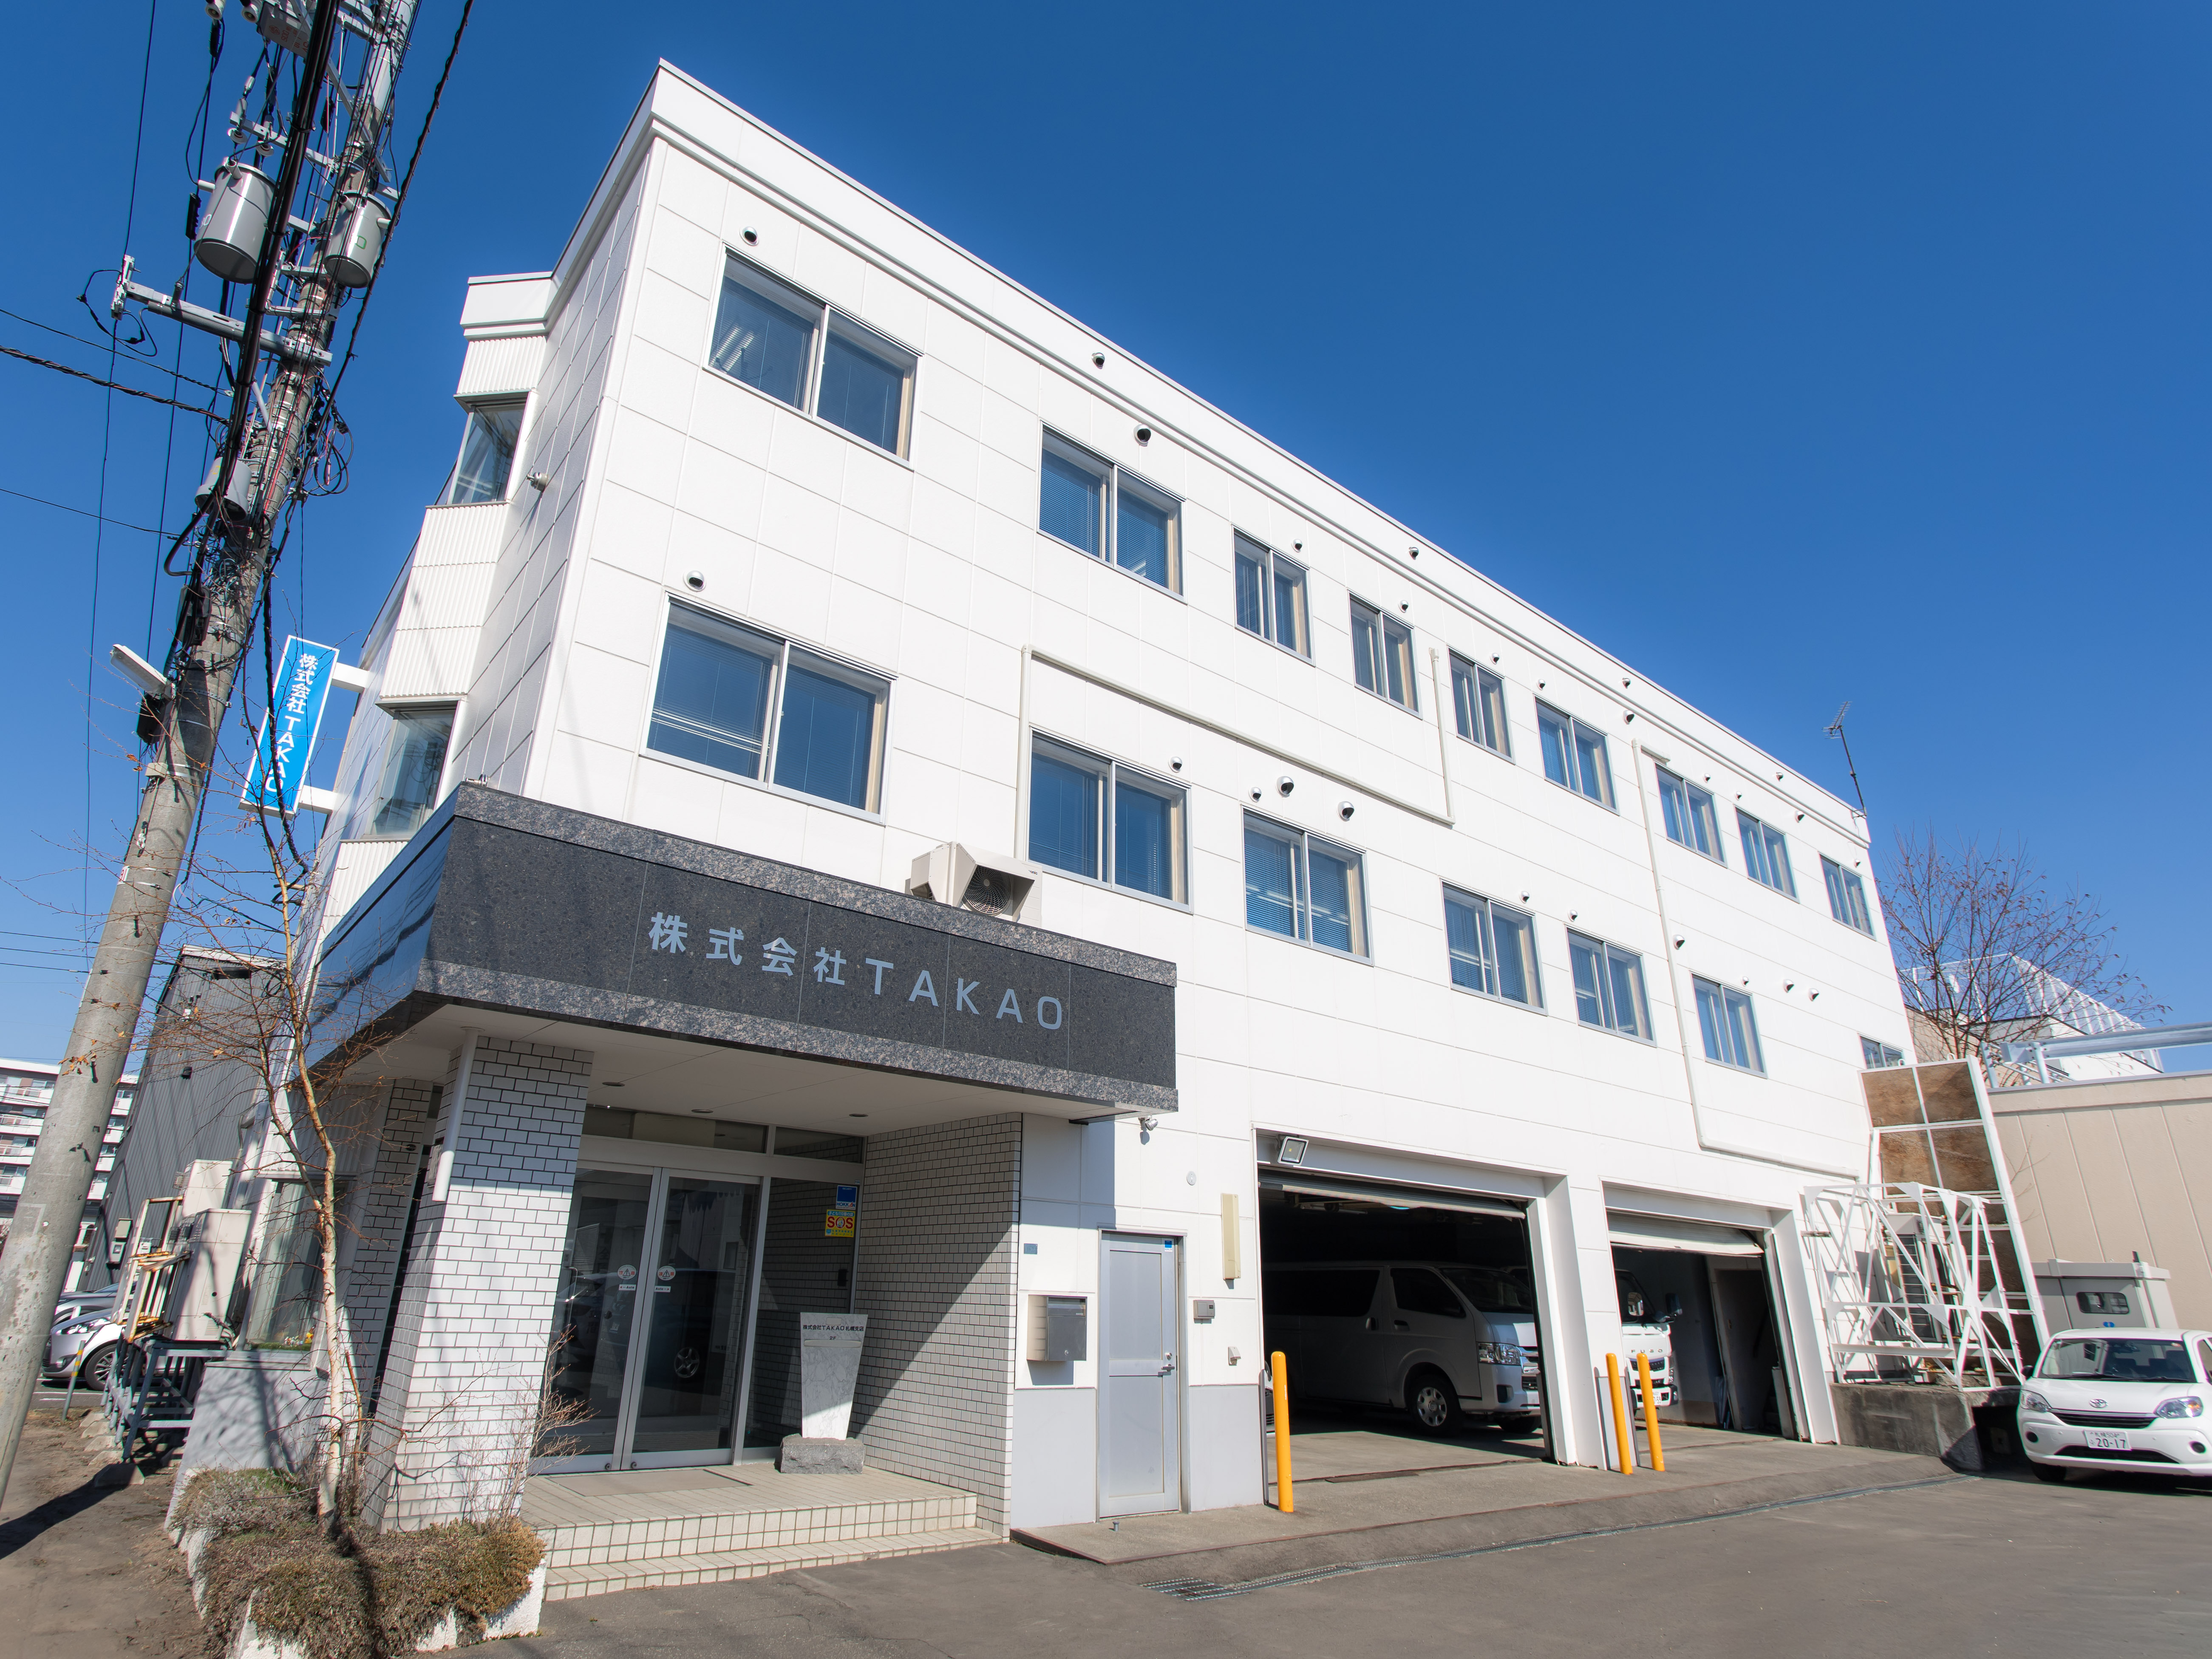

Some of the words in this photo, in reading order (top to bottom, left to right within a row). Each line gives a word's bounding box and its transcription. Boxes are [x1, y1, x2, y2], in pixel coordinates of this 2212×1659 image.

[649, 912, 1062, 1030] 株式会社TAKAO
[827, 1216, 853, 1229] SOS
[2096, 1438, 2125, 1449] 20-17
